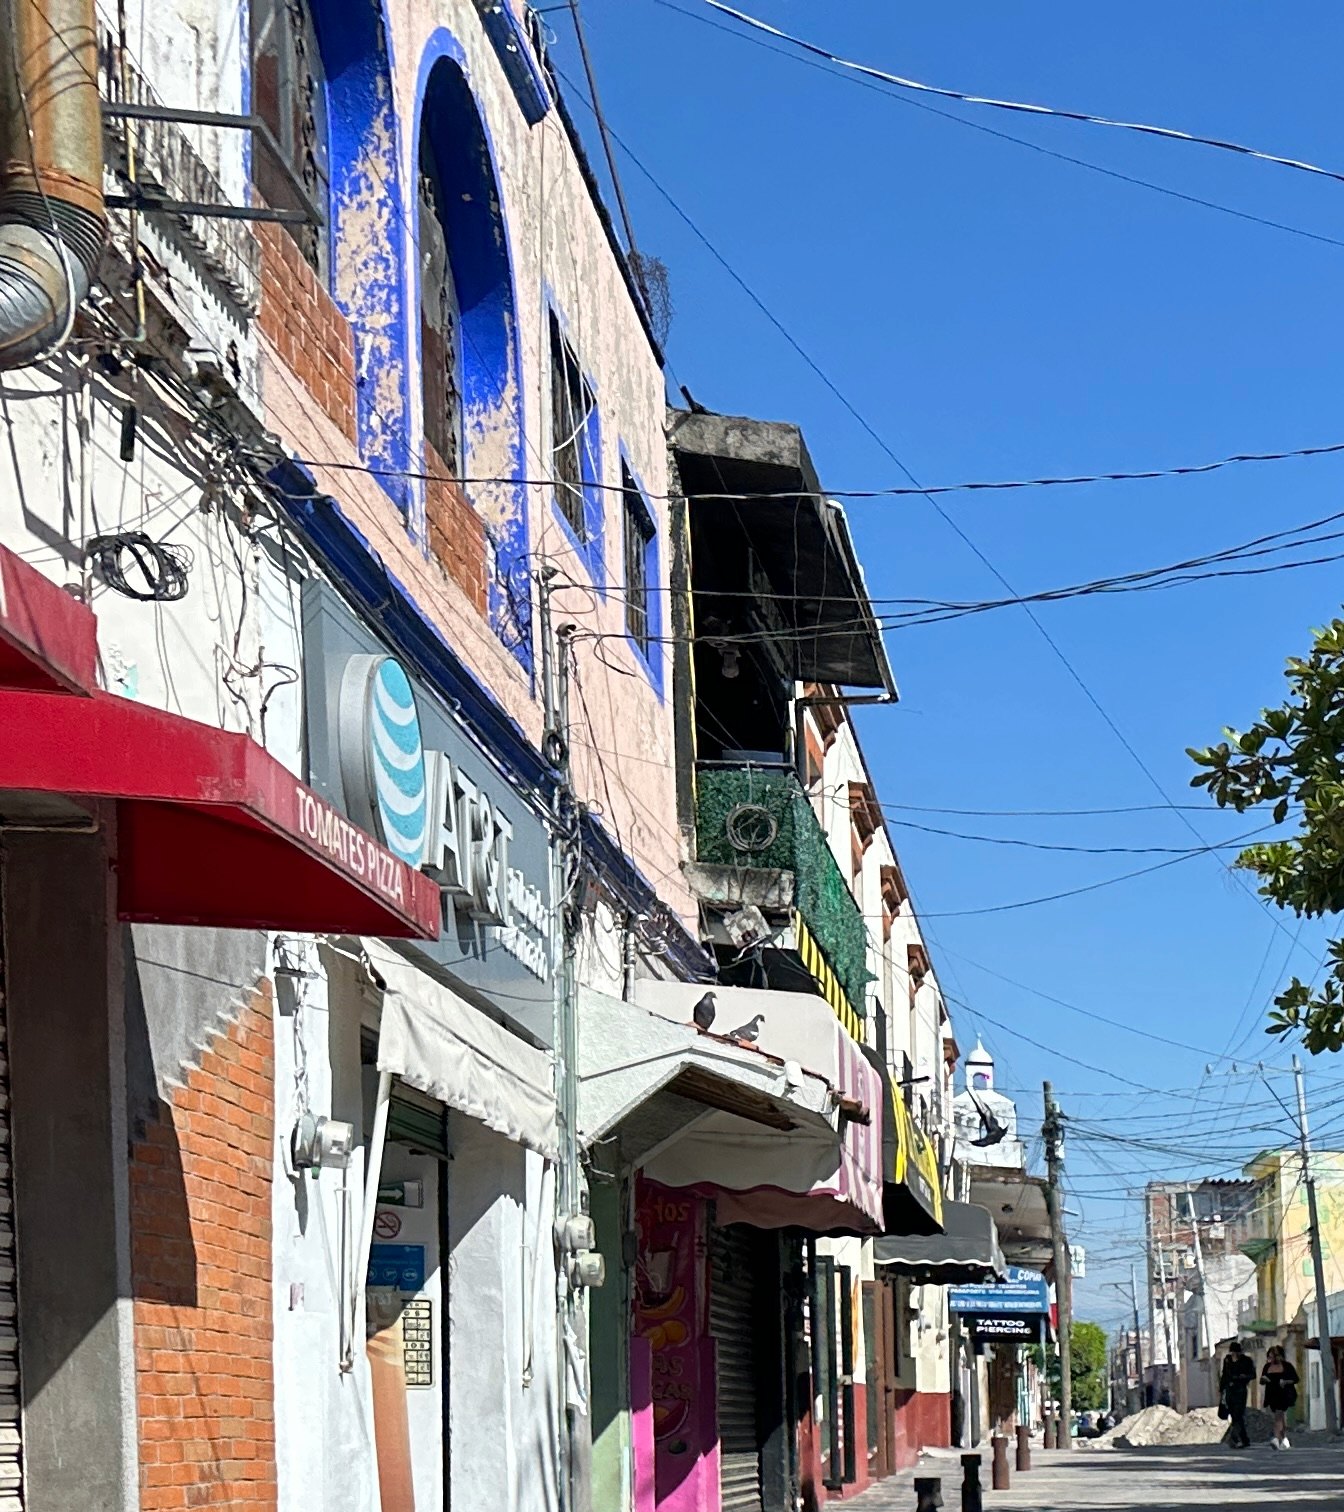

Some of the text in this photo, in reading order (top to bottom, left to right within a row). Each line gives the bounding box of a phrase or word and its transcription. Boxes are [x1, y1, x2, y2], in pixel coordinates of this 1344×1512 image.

[296, 787, 404, 905] TOMATES PIZZA
[976, 1319, 1025, 1327] TATTOO
[976, 1326, 1032, 1334] PIERCING
